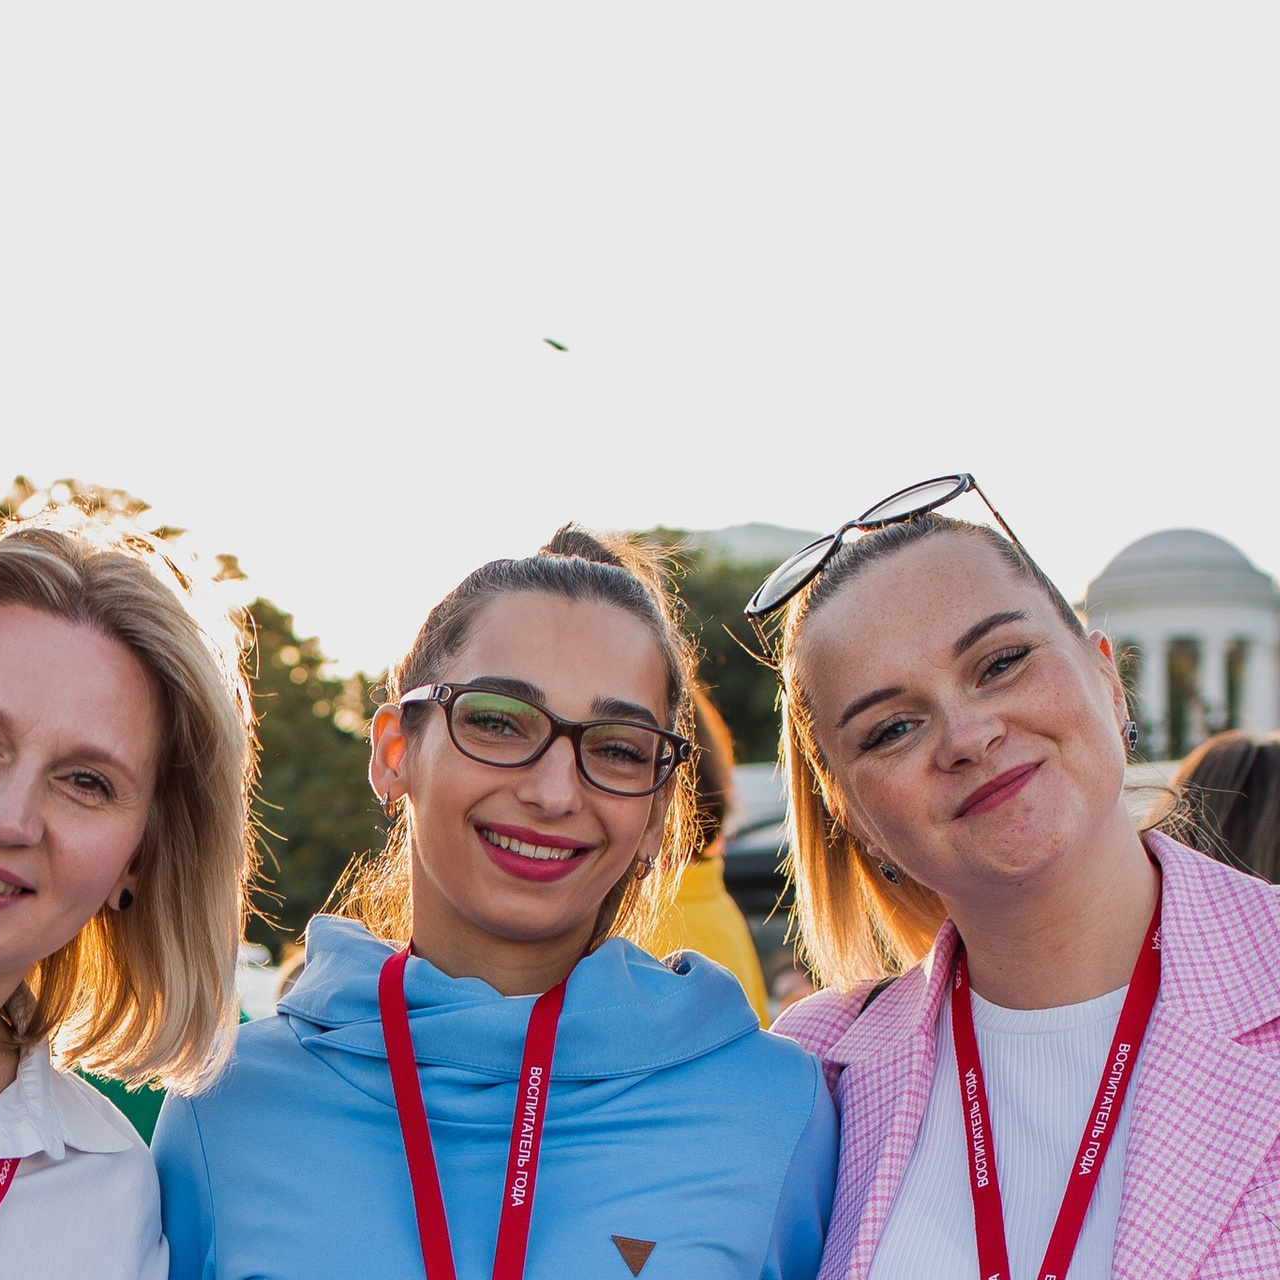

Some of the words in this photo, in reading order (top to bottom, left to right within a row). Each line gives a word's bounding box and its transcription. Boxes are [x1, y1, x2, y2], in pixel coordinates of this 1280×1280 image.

[965, 1067, 978, 1102] ГОДА
[1091, 1043, 1132, 1139] ВОСПИТАТЕЛЬ
[517, 1066, 543, 1168] ВОСПИТАТЕЛЬ
[968, 1101, 989, 1188] ВОСПИТАТЕЛЬ
[511, 1171, 528, 1208] ГОДА
[1078, 1140, 1102, 1177] ГОДА
